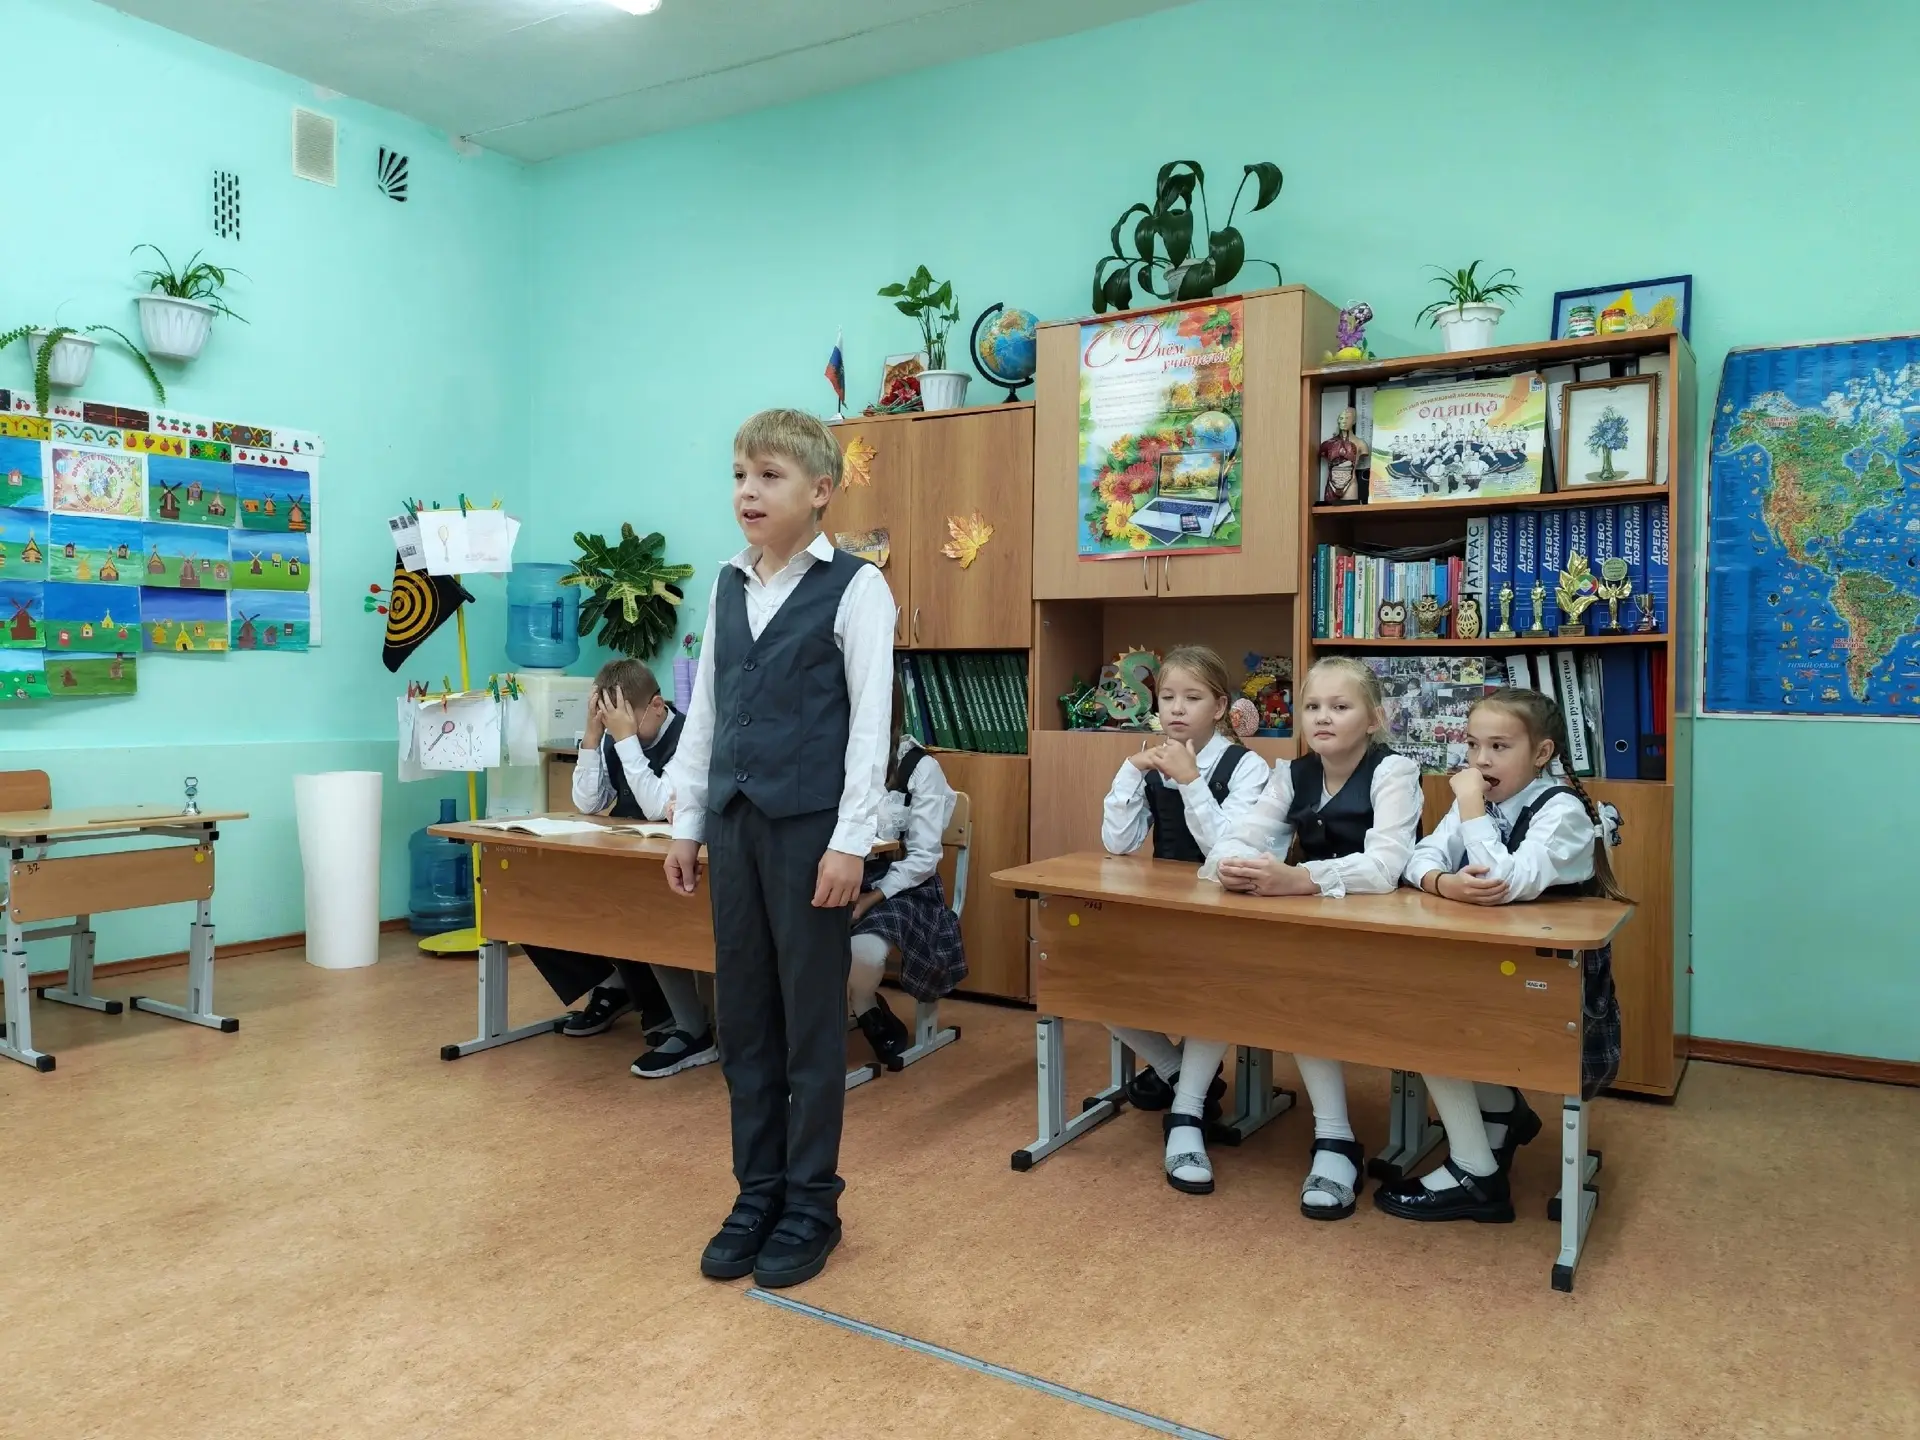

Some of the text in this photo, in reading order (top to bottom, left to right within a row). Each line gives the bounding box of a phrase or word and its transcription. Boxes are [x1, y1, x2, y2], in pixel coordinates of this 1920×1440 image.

[1084, 320, 1185, 368] С Днём
[1162, 347, 1233, 373] учителя!
[1467, 525, 1480, 589] АТЛАС
[1492, 530, 1501, 573] ДРЕВО
[1501, 516, 1509, 573] ПОЗНАНИЯ
[1517, 530, 1527, 573] ДРЕВО
[1543, 528, 1552, 571] ДРЕВО
[1552, 514, 1560, 572] ПОЗНАНИЯ
[1571, 524, 1579, 551] ЕВО
[1595, 522, 1605, 565] ДРЕВО
[1622, 520, 1632, 565] ДРЕВО
[1632, 506, 1640, 566] ПОЗНАНИЯ
[1651, 519, 1661, 566] ДРЕВО
[1562, 659, 1584, 761] Классное руководство
